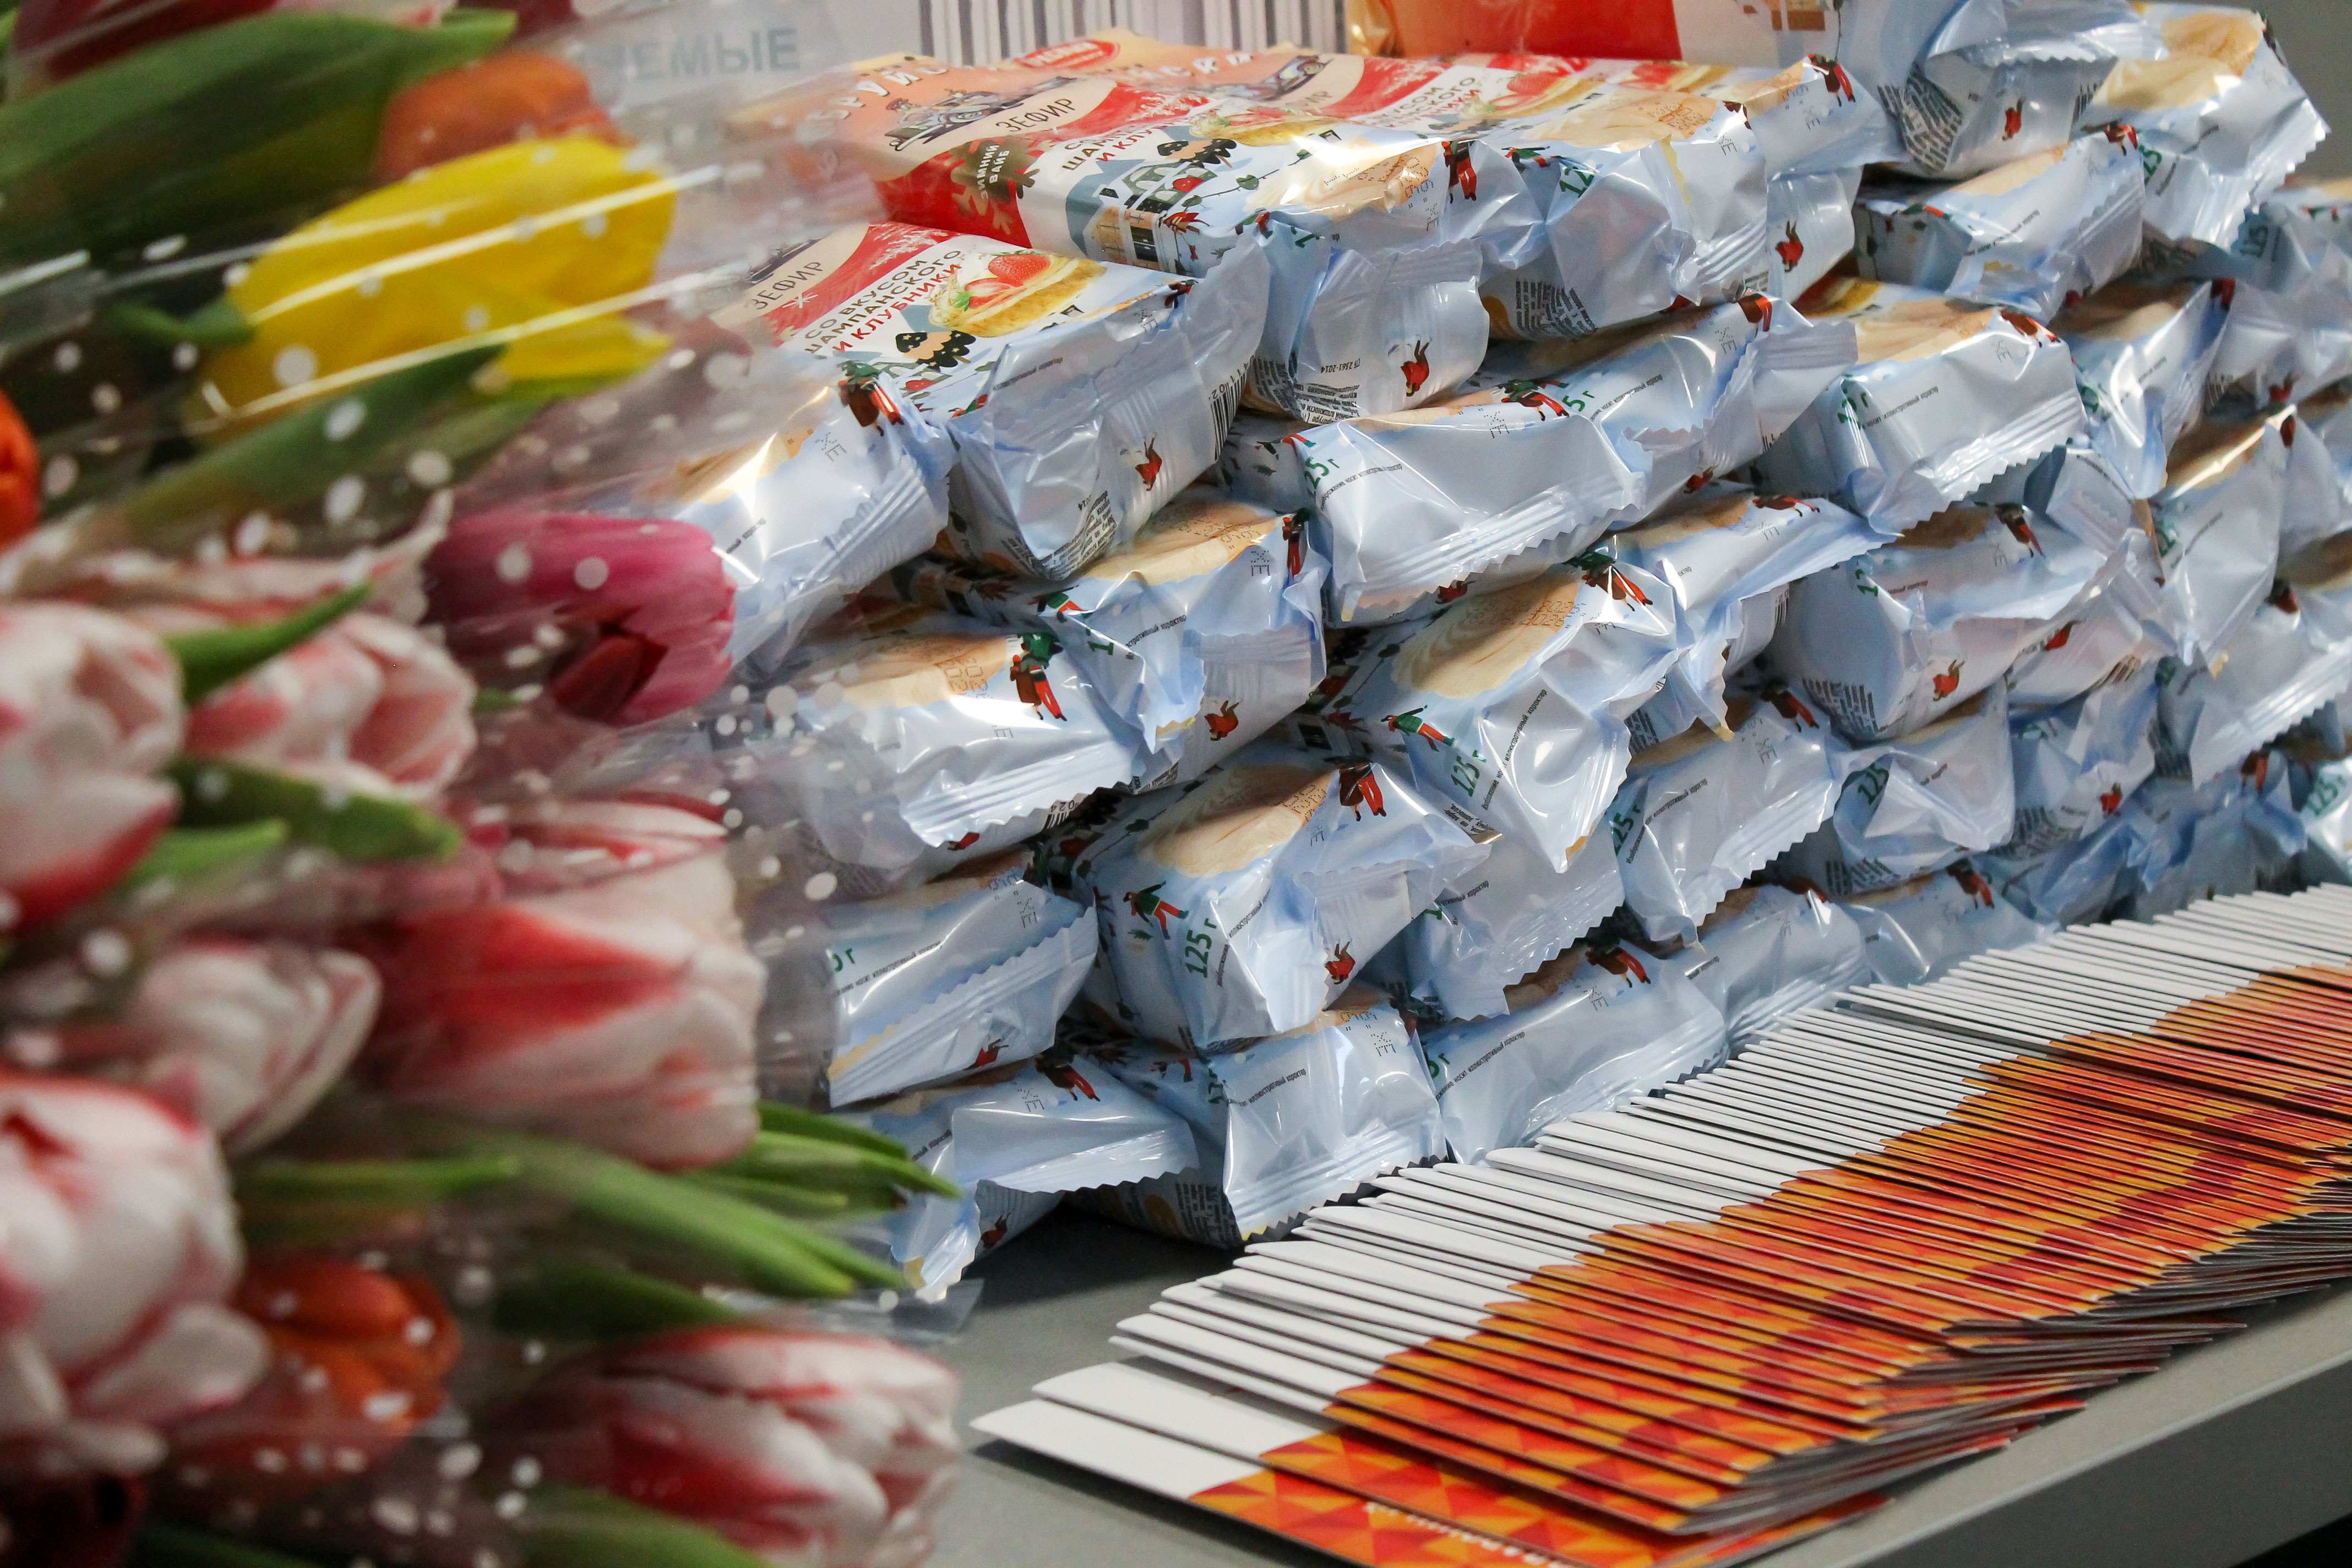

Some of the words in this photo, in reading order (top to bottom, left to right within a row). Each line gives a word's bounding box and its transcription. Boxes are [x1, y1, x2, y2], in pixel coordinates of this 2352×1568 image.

[590, 26, 801, 80] ЕМЫЕ
[995, 99, 1075, 132] ЗЕФИР
[989, 150, 1010, 184] ВАЙБ
[752, 262, 824, 310] ЗЕФИР
[804, 318, 837, 339] СО
[839, 259, 929, 315] ВКУСОМ
[804, 250, 962, 353] ШАМПАНСКОГО
[832, 341, 854, 353] И
[851, 263, 963, 341] КЛУБНИКИ
[1127, 624, 1159, 648] стративный
[1159, 614, 1187, 630] характер
[1496, 761, 1508, 780] нот
[1527, 689, 1548, 715] характер
[1450, 755, 1480, 797] 125
[1184, 929, 1212, 978] 125
[1204, 917, 1217, 929] г
[1286, 1068, 1306, 1082] характер
[1467, 1042, 1504, 1073] иллюстративный
[1503, 1031, 1526, 1047] характер
